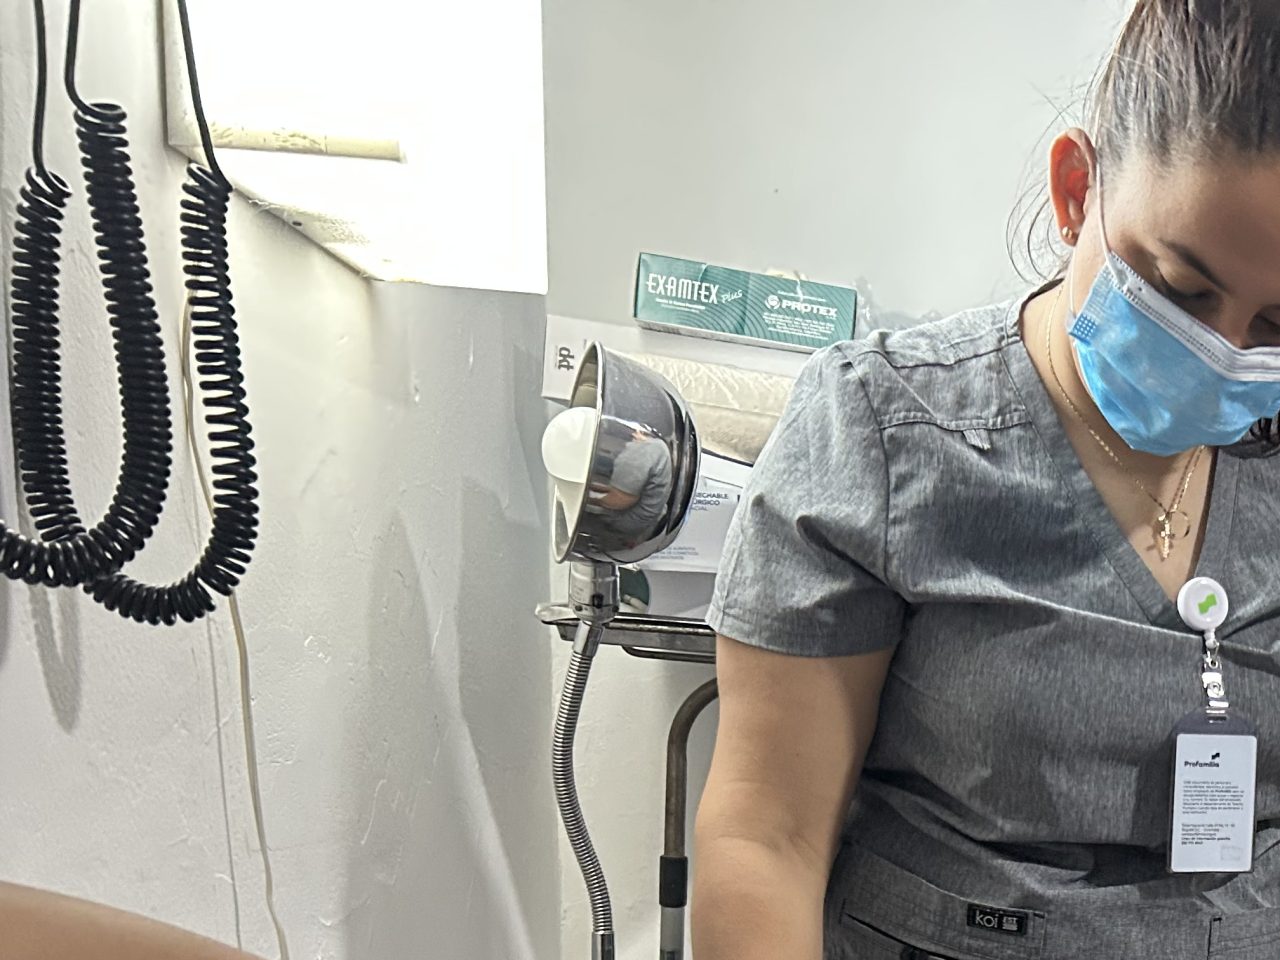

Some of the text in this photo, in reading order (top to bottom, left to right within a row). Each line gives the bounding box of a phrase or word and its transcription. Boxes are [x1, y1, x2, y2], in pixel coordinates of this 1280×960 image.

[646, 273, 719, 304] EXAMTEX
[781, 299, 837, 317] PROTEX
[558, 346, 575, 371] dkt
[975, 909, 999, 928] koi
